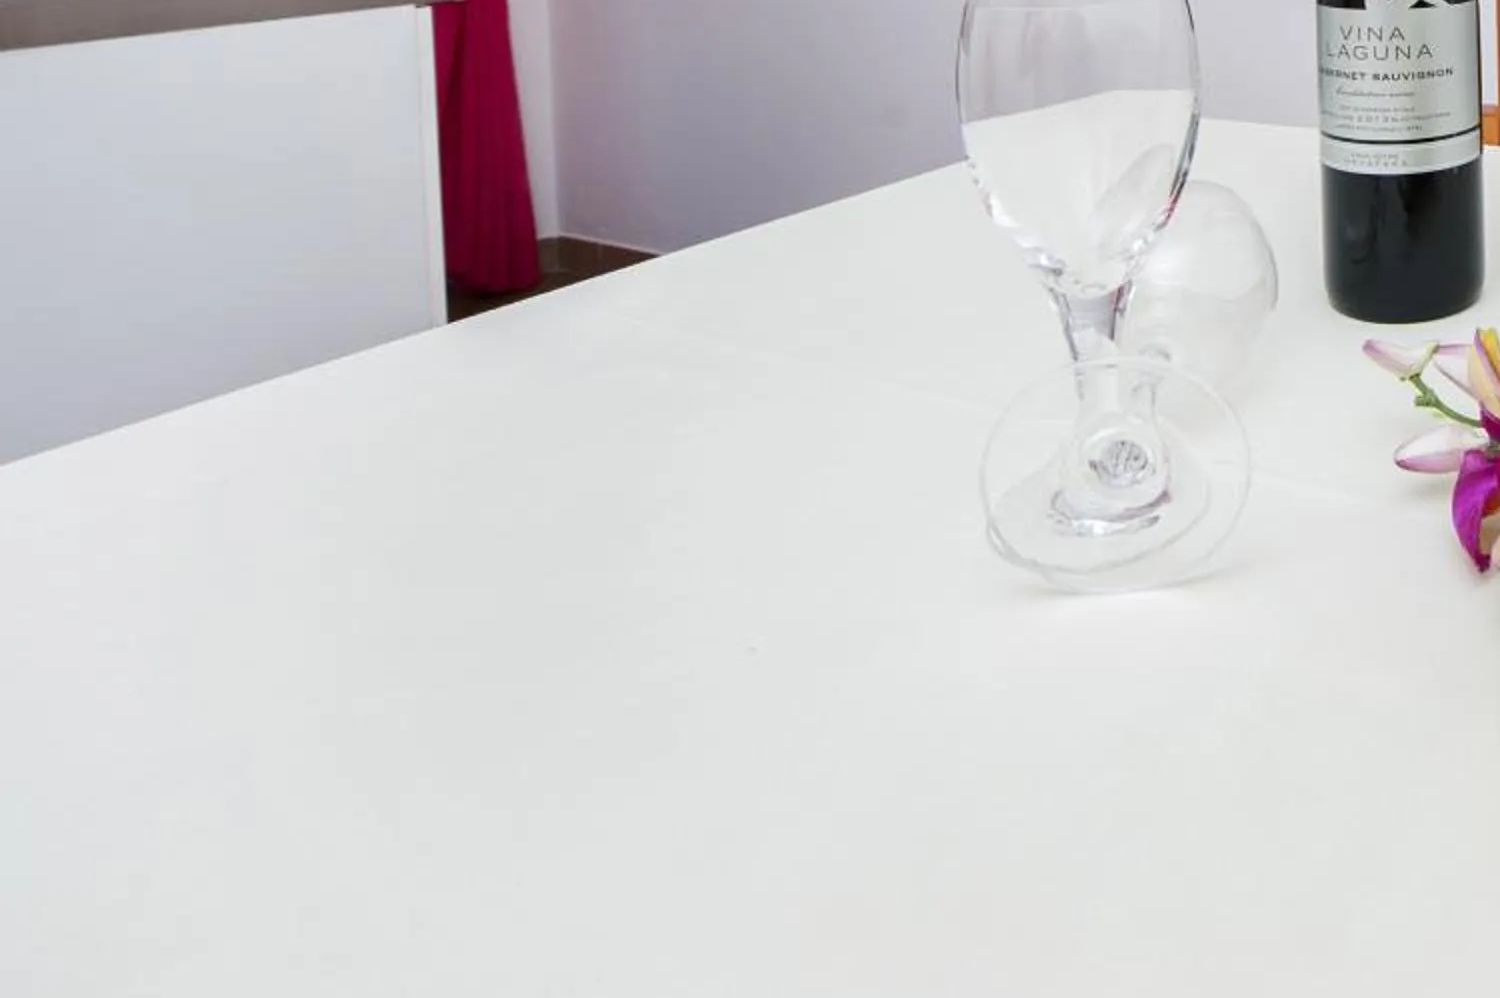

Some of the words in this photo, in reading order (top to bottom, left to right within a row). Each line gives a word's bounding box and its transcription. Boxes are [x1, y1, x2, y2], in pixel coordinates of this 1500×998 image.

[1339, 25, 1406, 42] VINA
[1325, 42, 1434, 61] LAGUNA
[1318, 66, 1367, 81] ABERNET
[1371, 67, 1454, 81] SAUVIGNON
